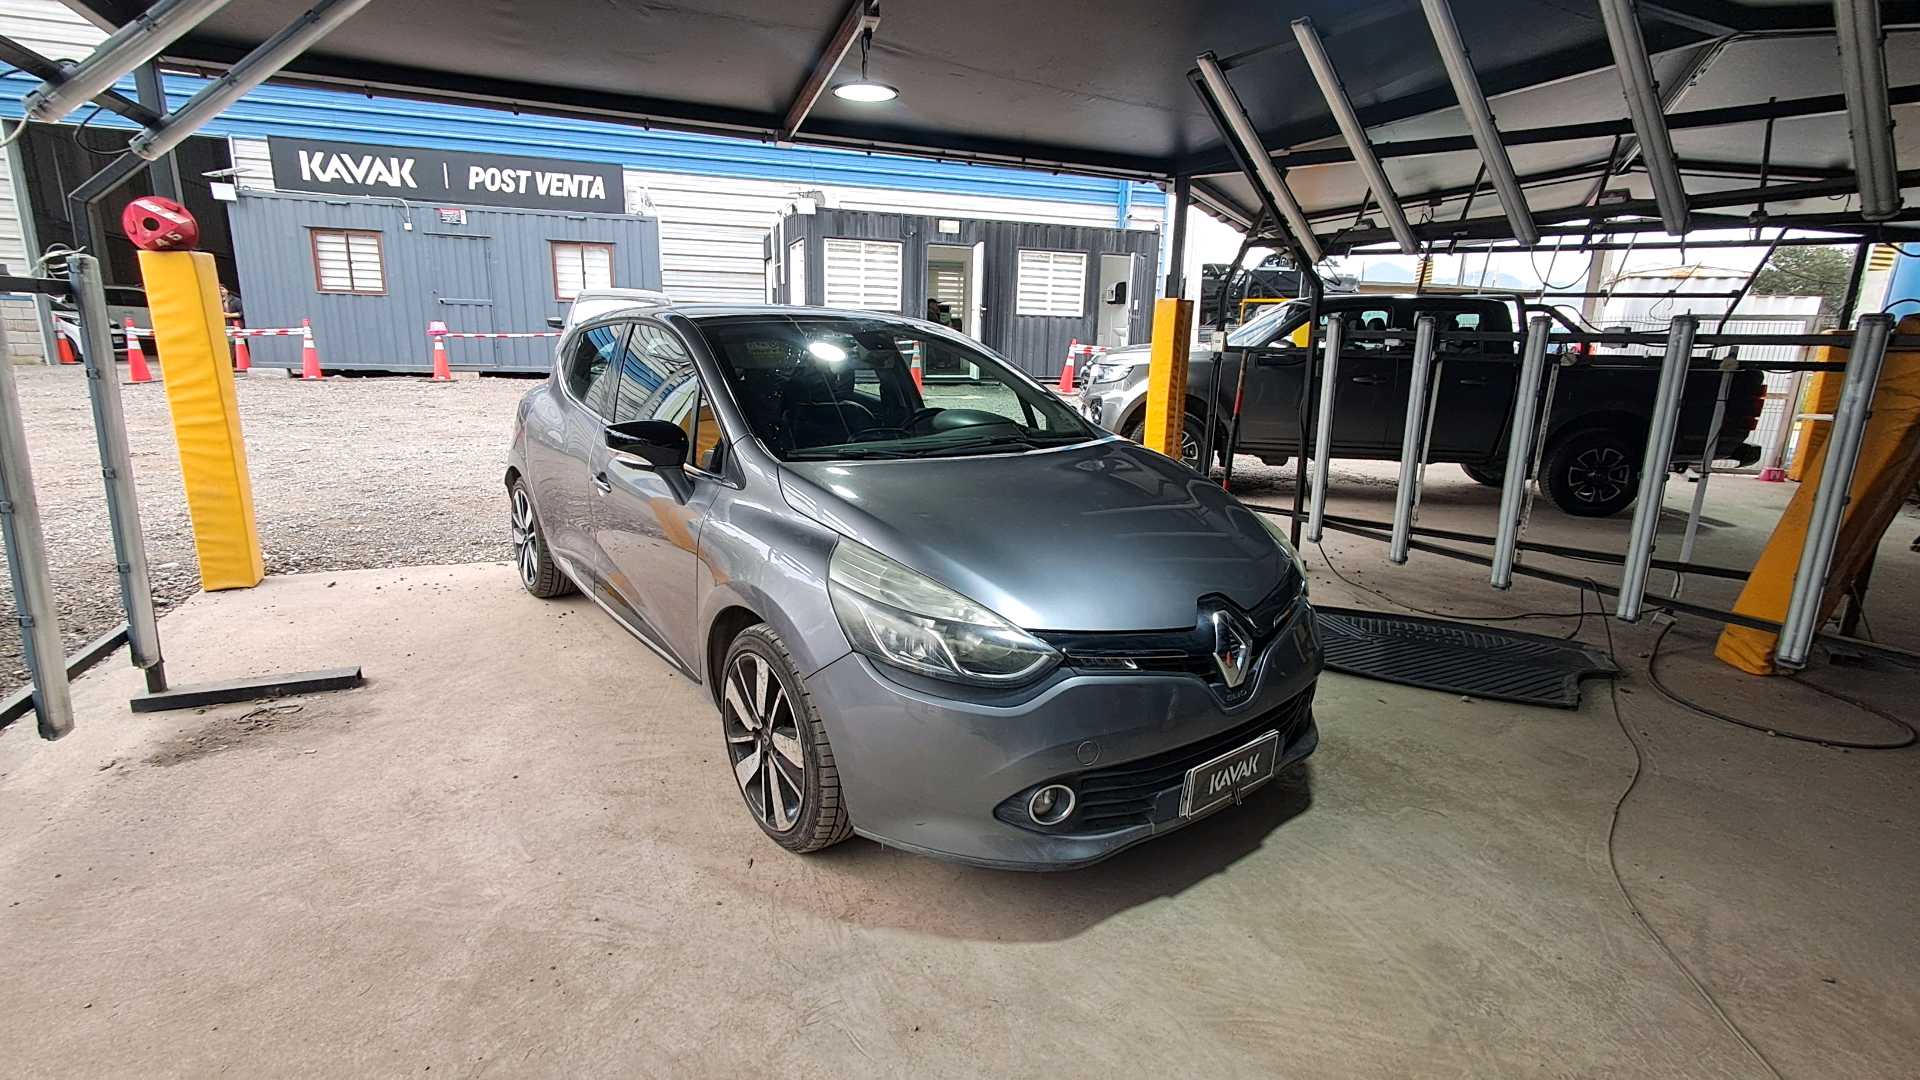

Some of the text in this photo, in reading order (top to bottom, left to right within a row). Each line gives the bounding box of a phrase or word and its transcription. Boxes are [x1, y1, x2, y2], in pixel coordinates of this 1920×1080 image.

[299, 150, 418, 188] KAVAK
[468, 166, 606, 200] POST VENTA
[1209, 753, 1260, 795] KAVAK
